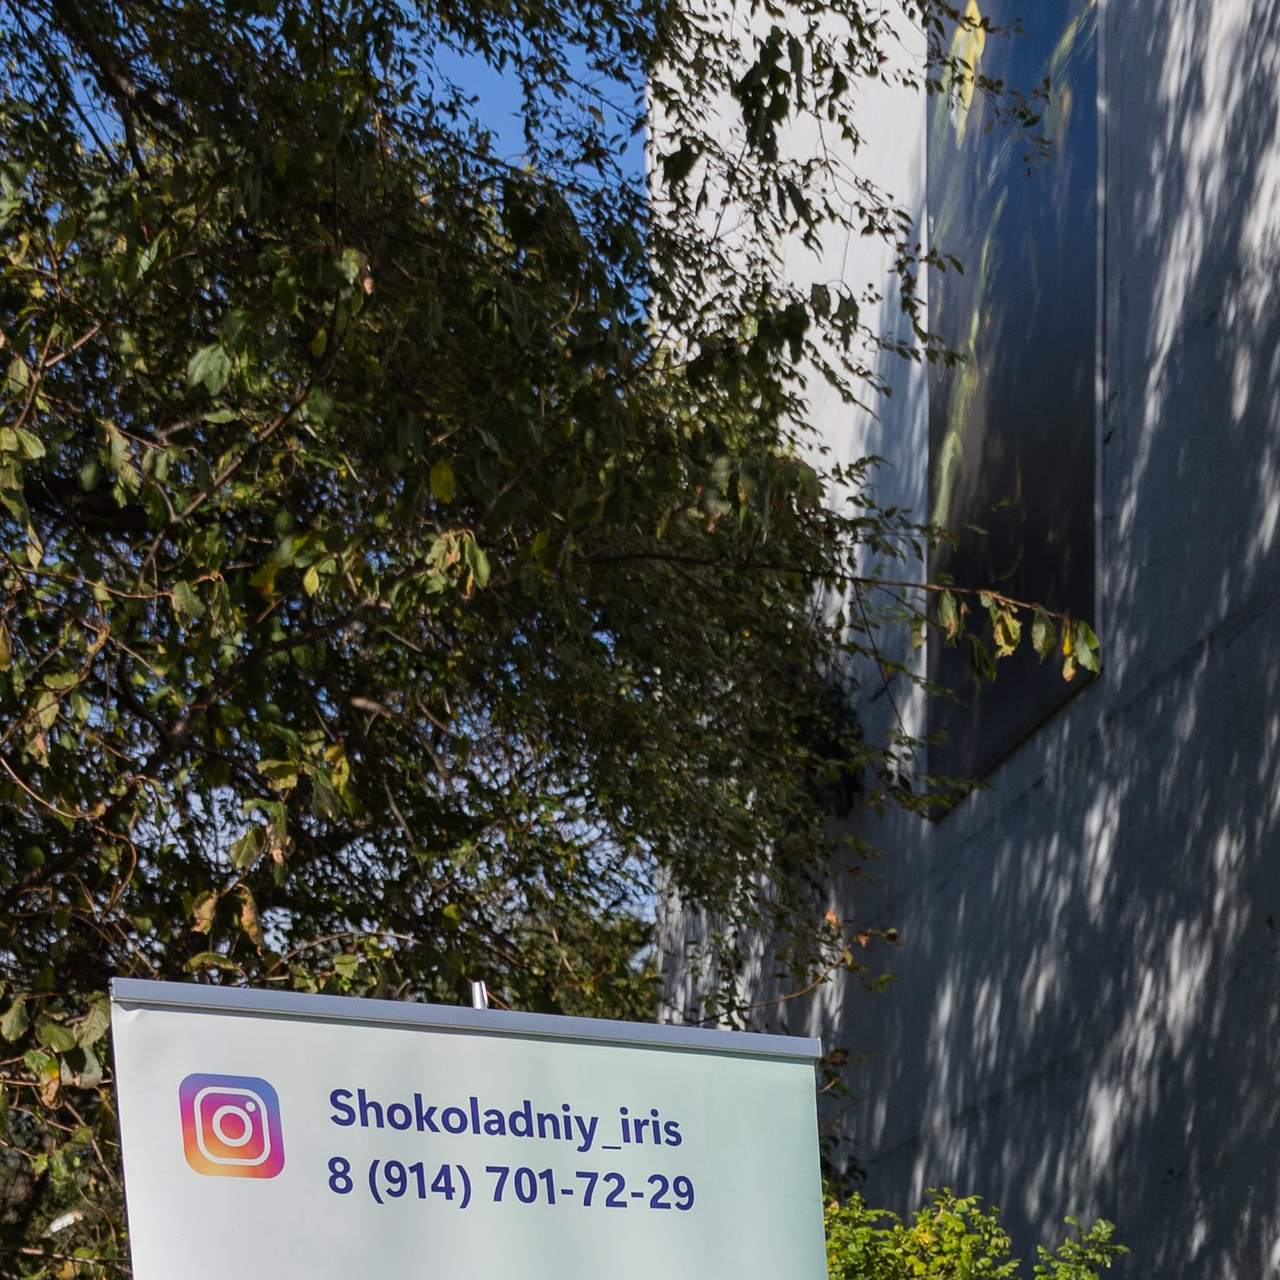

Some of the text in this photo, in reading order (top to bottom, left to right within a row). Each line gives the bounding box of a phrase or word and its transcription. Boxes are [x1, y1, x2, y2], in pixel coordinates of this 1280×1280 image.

[330, 1089, 682, 1152] Shokoladniy_iris
[328, 1157, 694, 1210] 8 (914) 701-72-29
